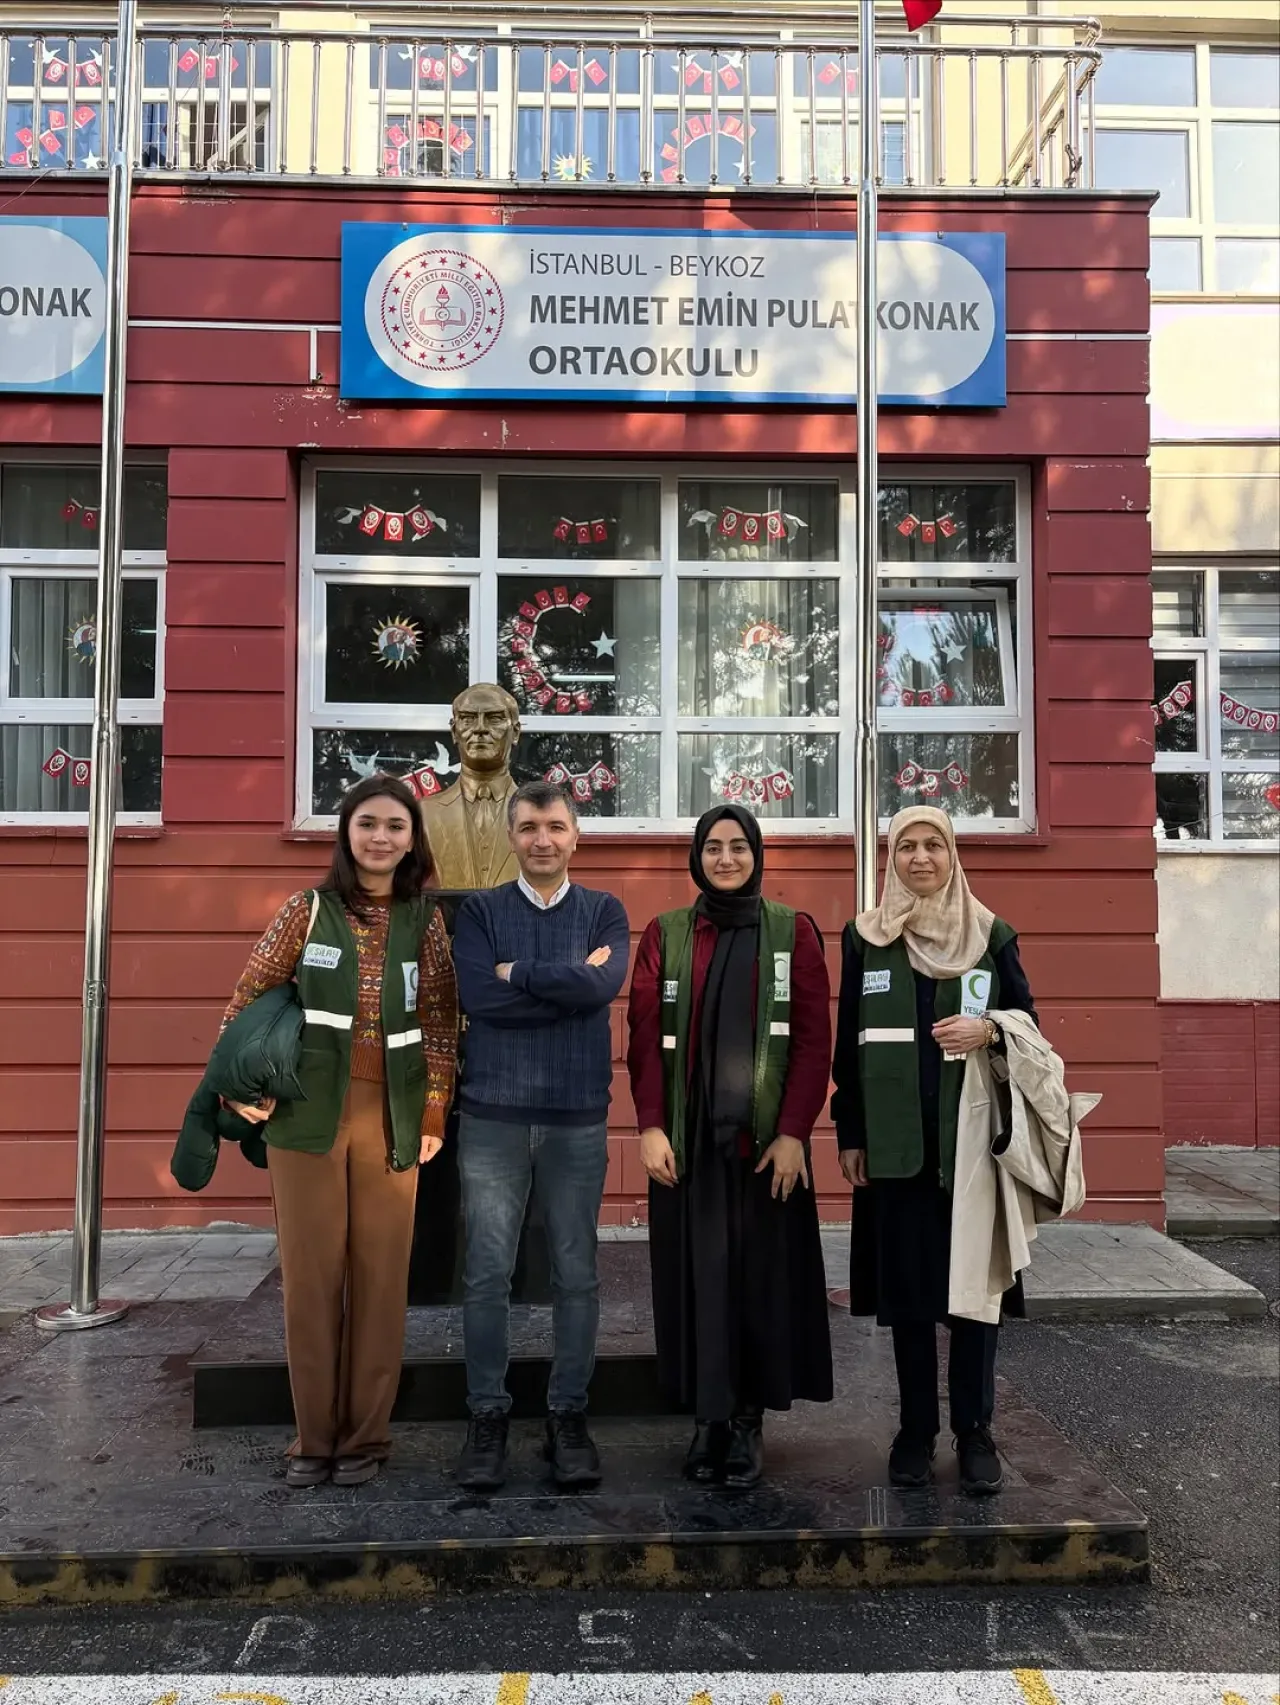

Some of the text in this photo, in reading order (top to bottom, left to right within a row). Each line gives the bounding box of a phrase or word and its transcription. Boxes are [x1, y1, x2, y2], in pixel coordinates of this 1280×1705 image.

[530, 249, 648, 276] İSTANBUL
[670, 255, 765, 278] BEYKOZ
[530, 294, 670, 326] MEHMET
[678, 290, 758, 328] EMİN
[528, 344, 759, 378] ORTAOKULU
